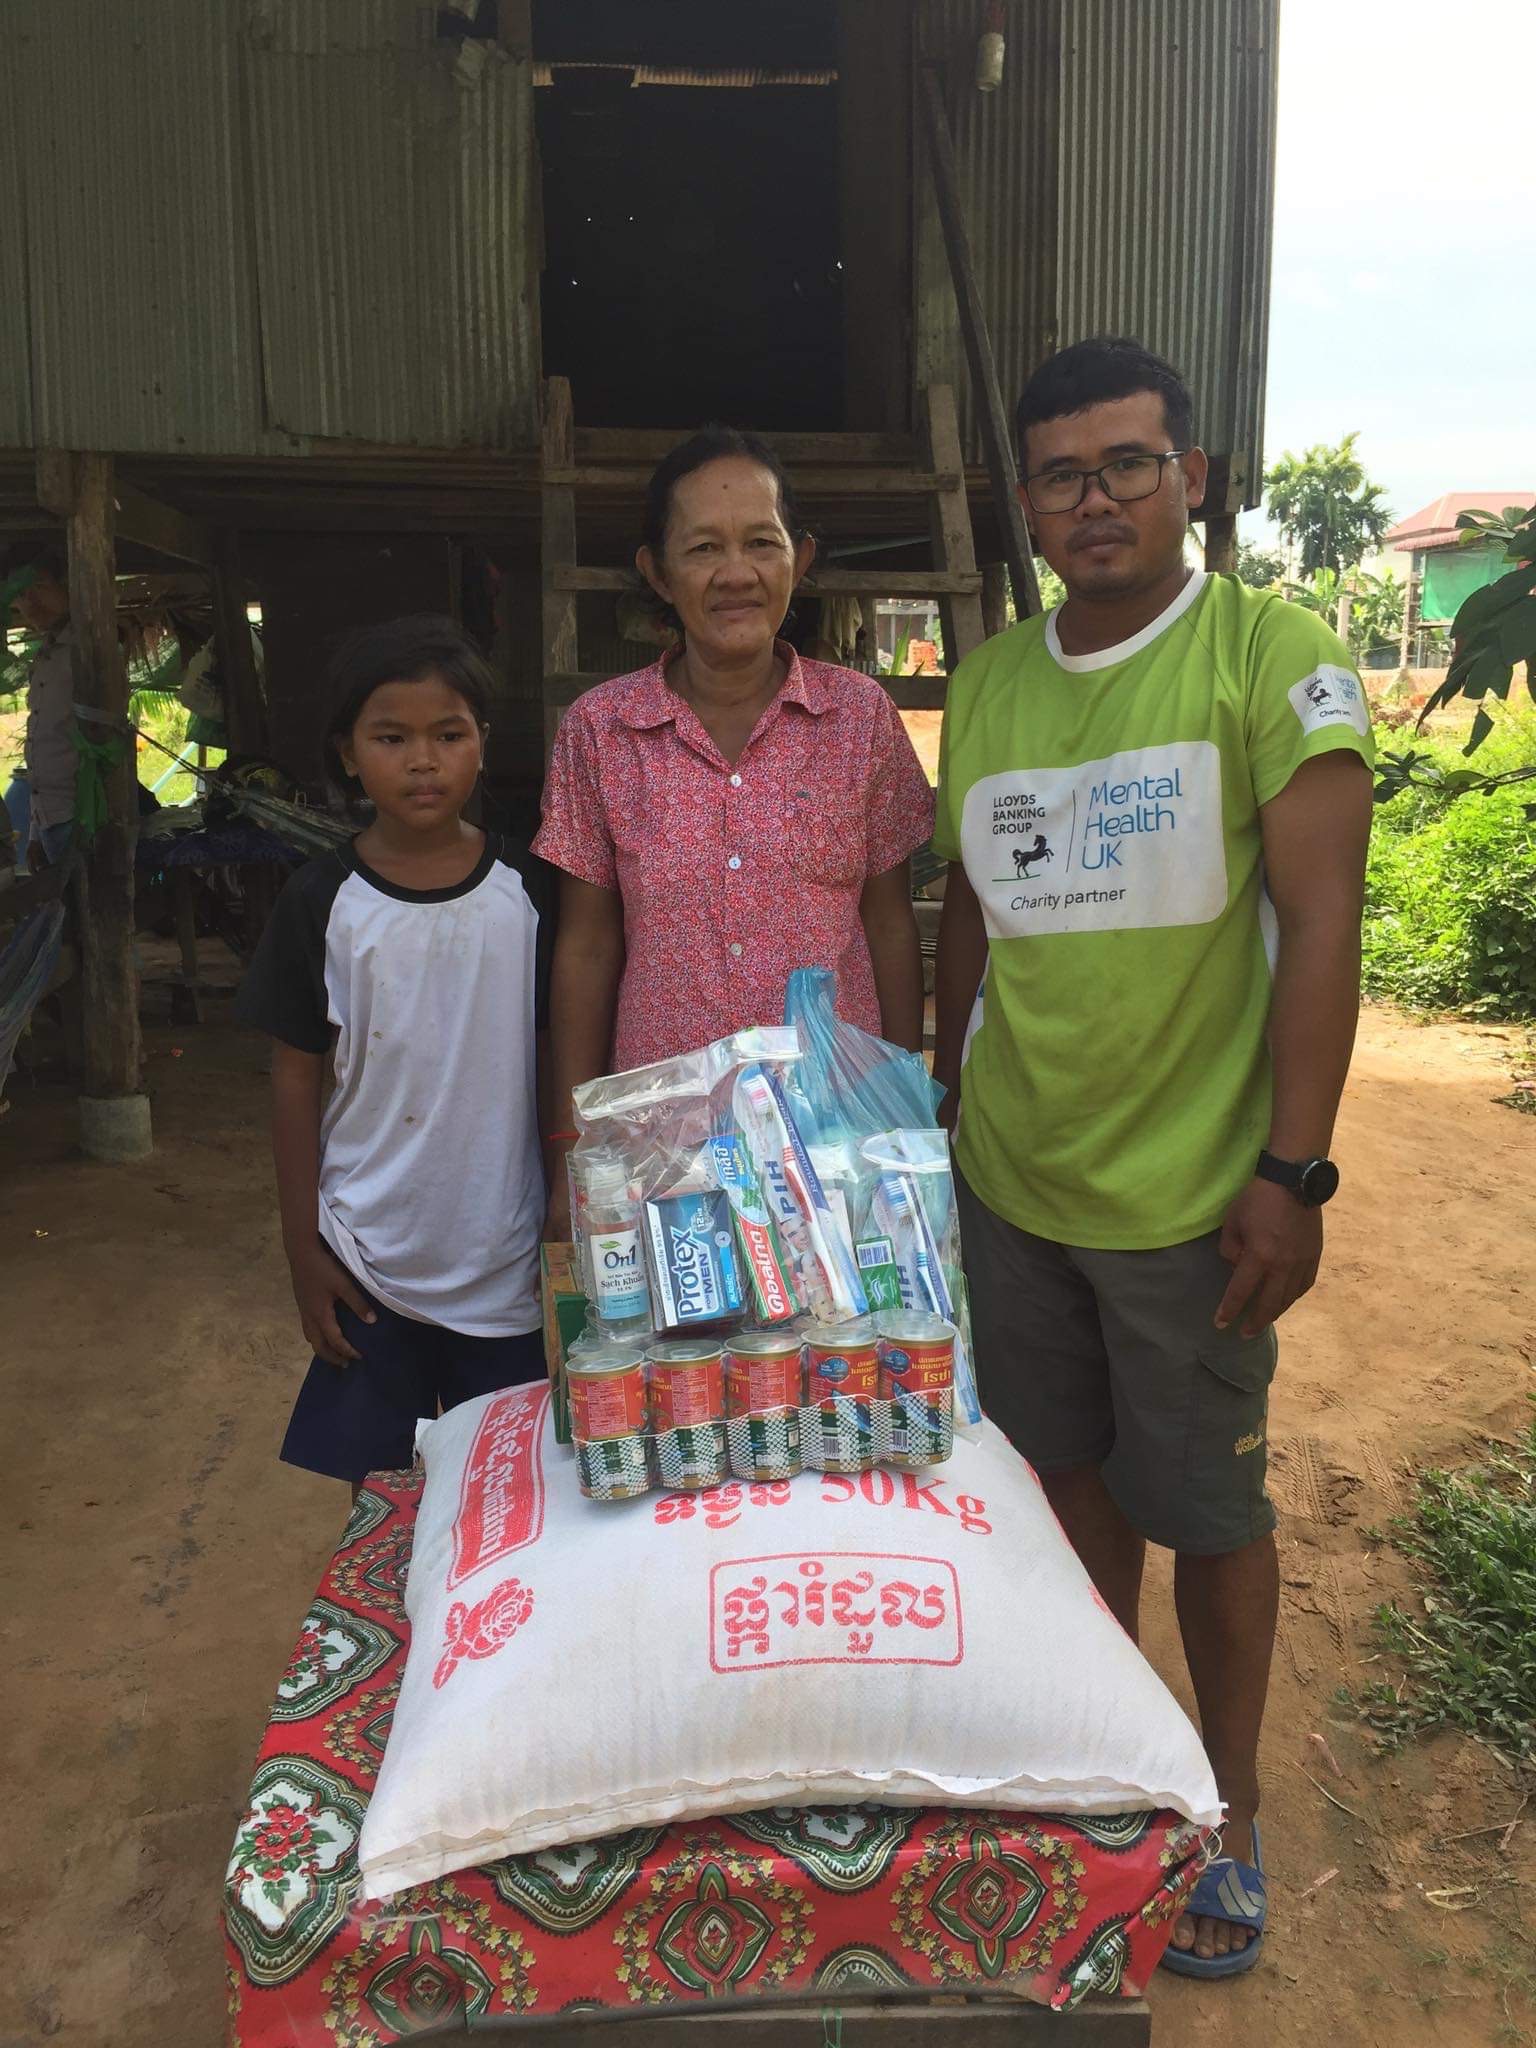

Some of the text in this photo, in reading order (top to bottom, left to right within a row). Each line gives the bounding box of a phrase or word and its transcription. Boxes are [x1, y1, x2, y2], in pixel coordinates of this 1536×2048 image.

[993, 794, 1036, 808] LLOYDS
[1089, 768, 1183, 810] Mental
[992, 807, 1046, 822] BANKING
[992, 822, 1032, 835] GROUP
[1084, 802, 1175, 840] Health
[1082, 840, 1123, 870] UK
[1010, 888, 1126, 911] Charity partner
[604, 1245, 636, 1269] On1
[670, 1227, 703, 1317] Protex
[699, 1253, 713, 1294] MEN
[750, 1229, 784, 1314] คอลเกต
[820, 1468, 992, 1536] 50Kg
